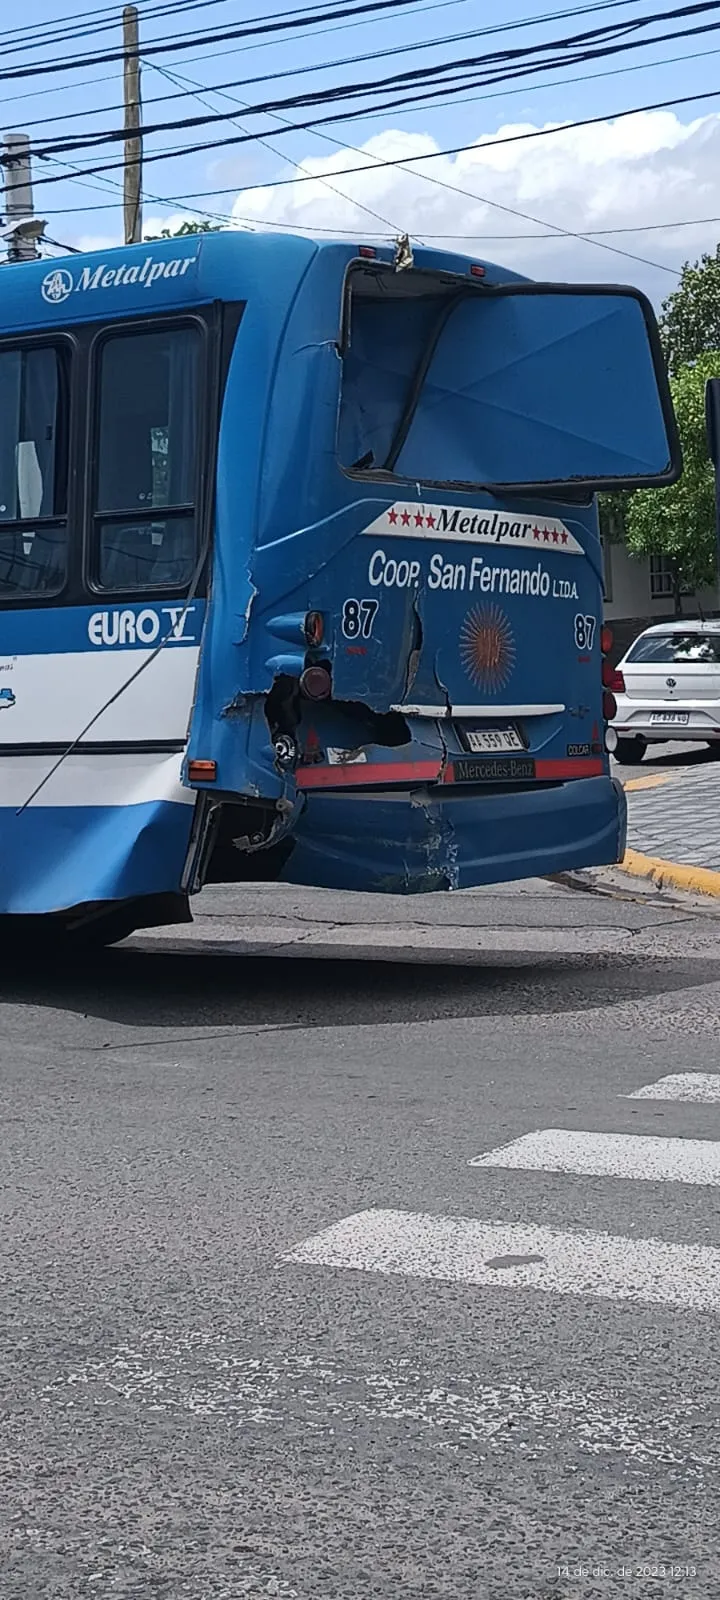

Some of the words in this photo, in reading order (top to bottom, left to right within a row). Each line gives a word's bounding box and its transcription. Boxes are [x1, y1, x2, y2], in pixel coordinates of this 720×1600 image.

[74, 257, 196, 292] Metalpar
[436, 509, 531, 541] Metalpar
[427, 554, 466, 590] San
[469, 557, 550, 597] Fernando
[88, 609, 160, 645] EURO
[342, 599, 379, 639] 87
[574, 613, 596, 650] 87
[482, 733, 503, 748] 559
[457, 759, 534, 779] Mercedes-Benz
